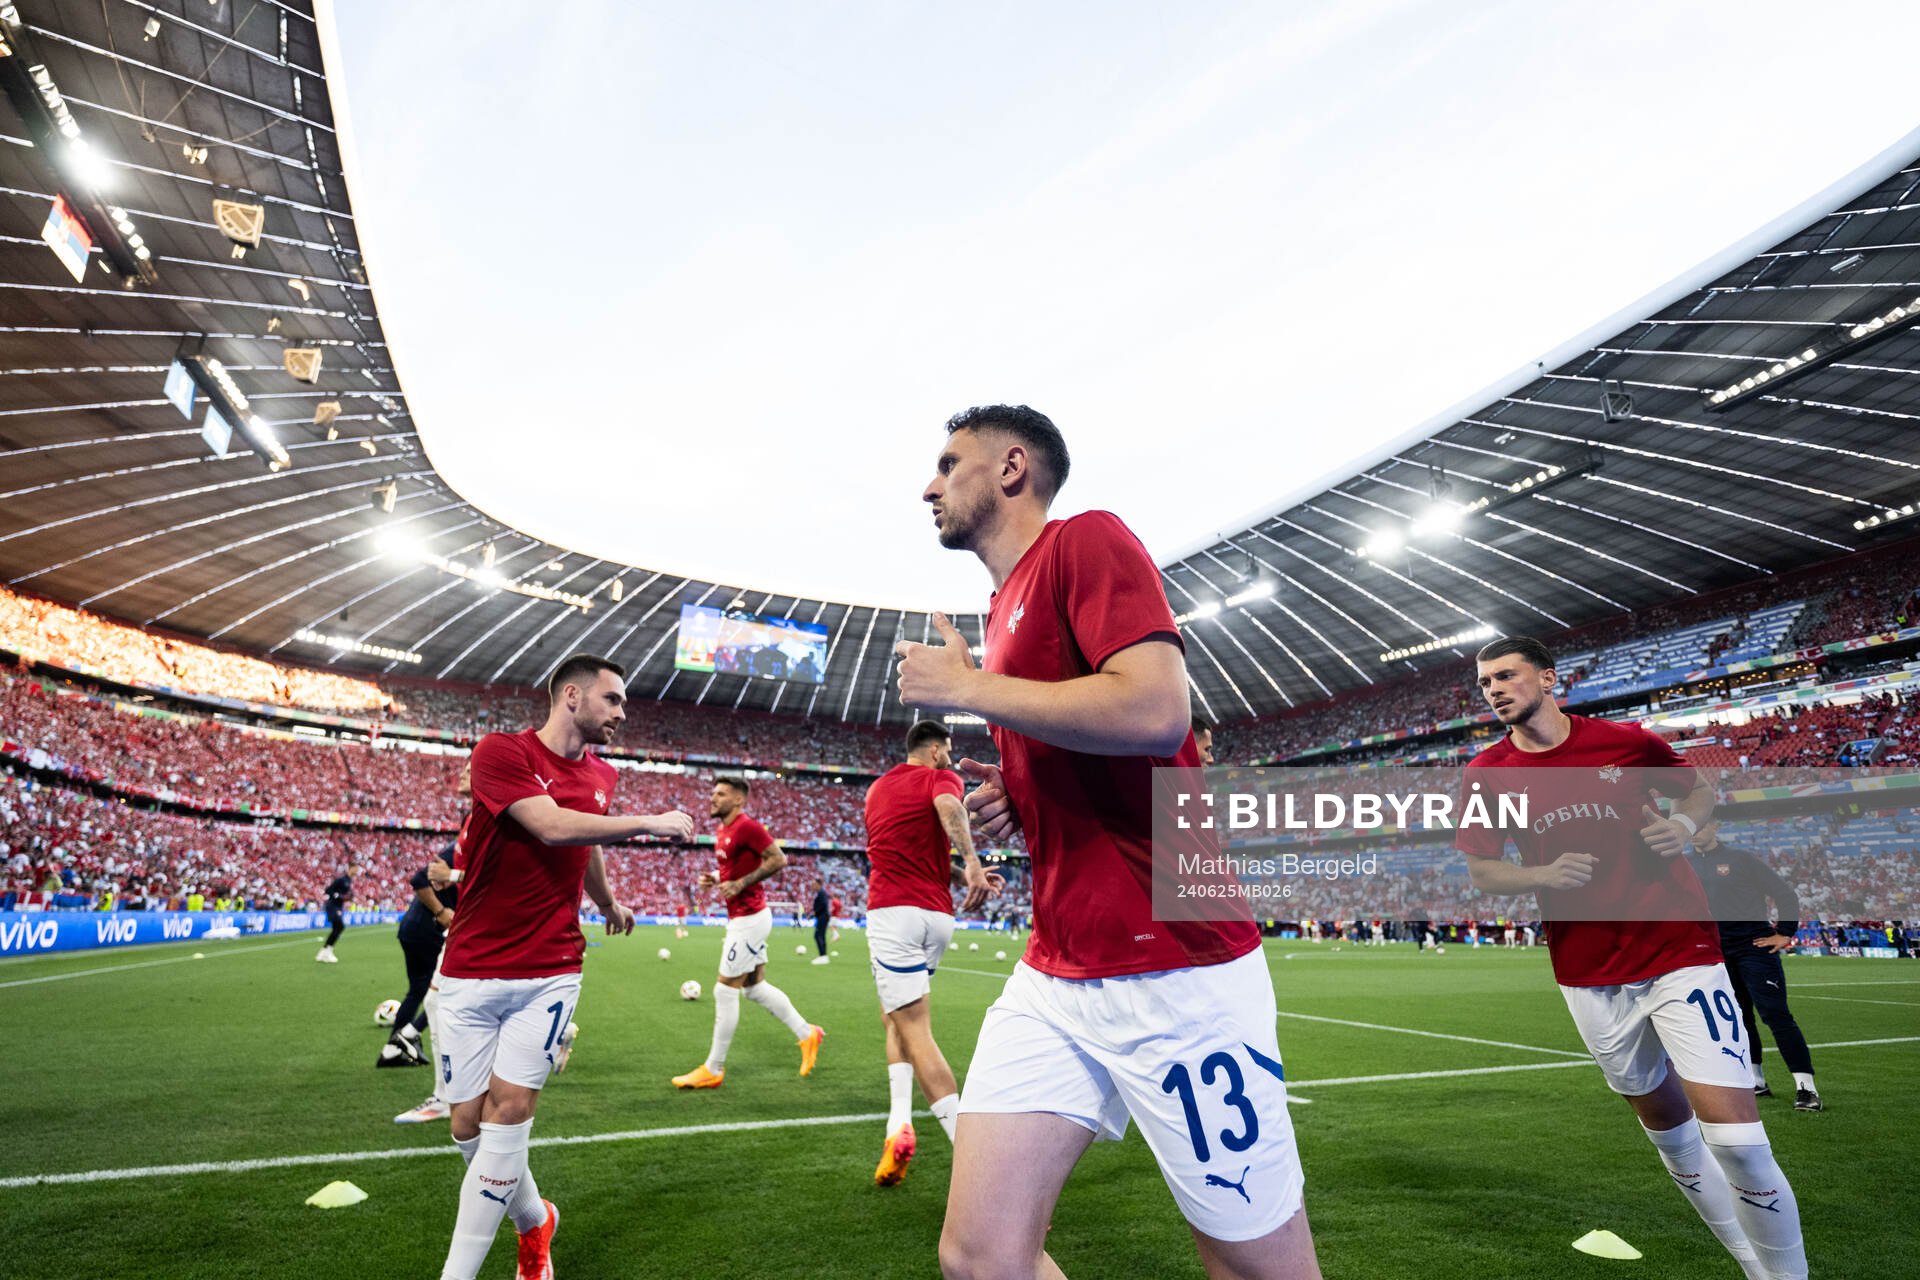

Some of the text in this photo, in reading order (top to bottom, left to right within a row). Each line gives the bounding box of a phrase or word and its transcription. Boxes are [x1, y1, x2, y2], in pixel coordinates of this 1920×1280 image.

[1533, 803, 1621, 834] СРБИЈА
[728, 942, 737, 961] 6
[1686, 988, 1740, 1043] 19
[1161, 1051, 1259, 1163] 13
